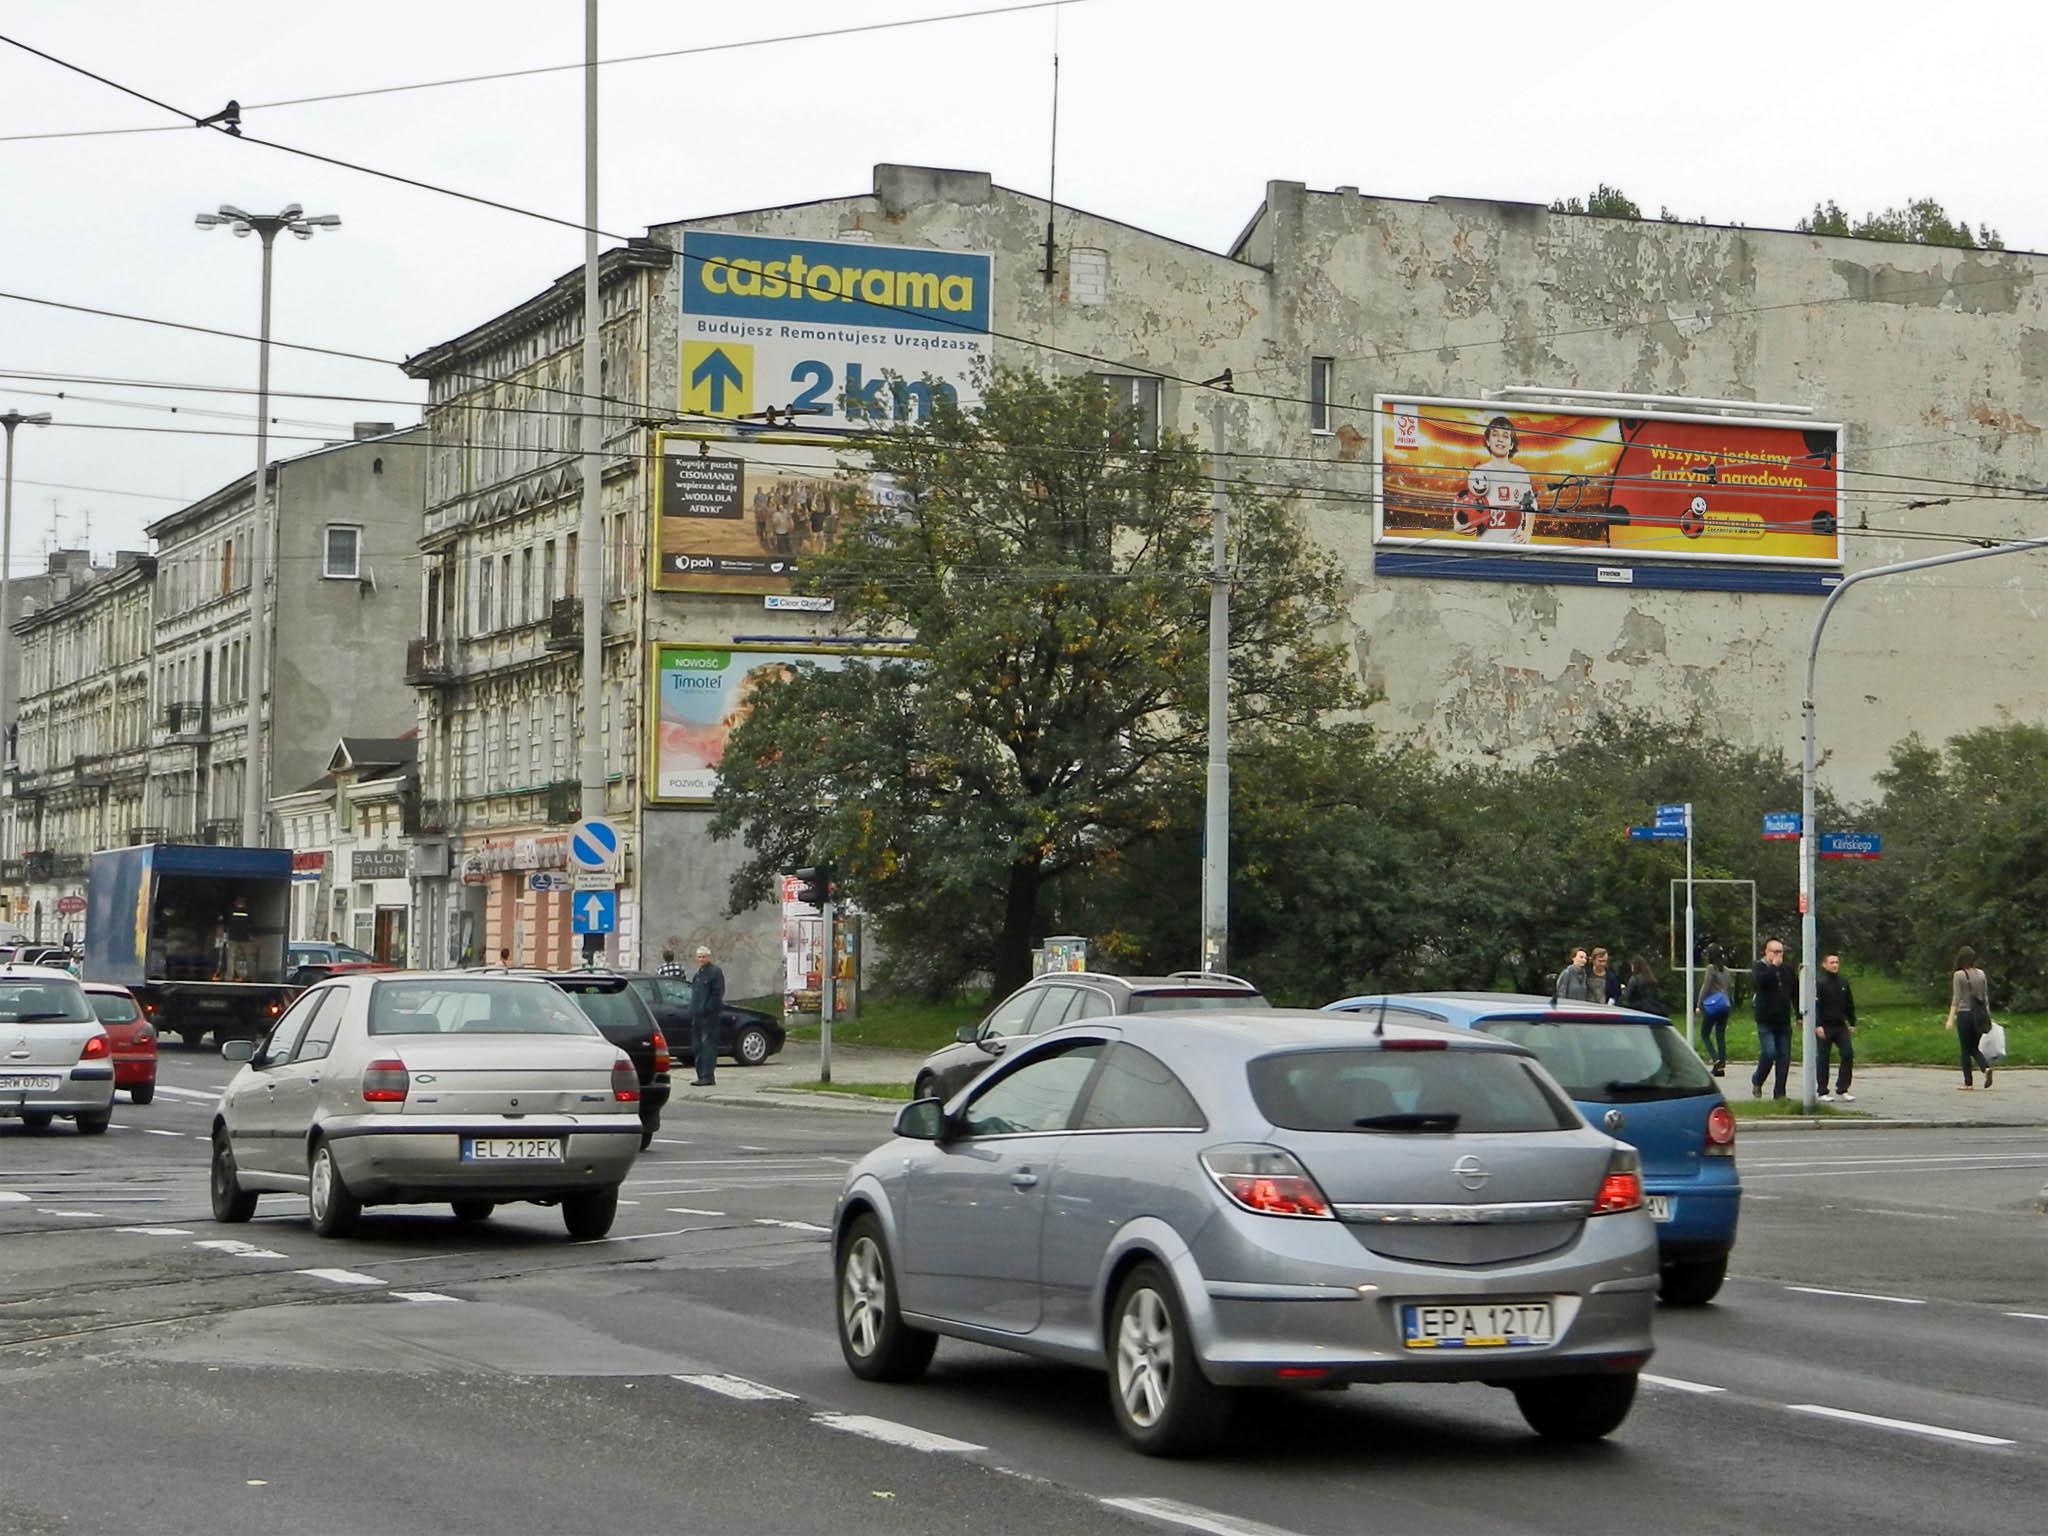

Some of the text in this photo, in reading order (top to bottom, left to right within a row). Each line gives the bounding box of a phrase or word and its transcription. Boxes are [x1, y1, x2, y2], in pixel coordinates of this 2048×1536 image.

[701, 254, 973, 312] castorama
[697, 320, 976, 351] Budujesz Remontujesz Urządzasz
[1650, 444, 1791, 470] Wszyscy jesteśmy
[679, 470, 735, 481] CISOWIANKI
[1722, 470, 1807, 492] narodową.
[690, 557, 713, 569] pah
[675, 657, 719, 669] NOWOŚĆ
[672, 674, 722, 689] Timotei
[353, 854, 405, 864] SALON
[475, 1141, 558, 1158] EL 212FK
[1423, 1309, 1477, 1336] EPA
